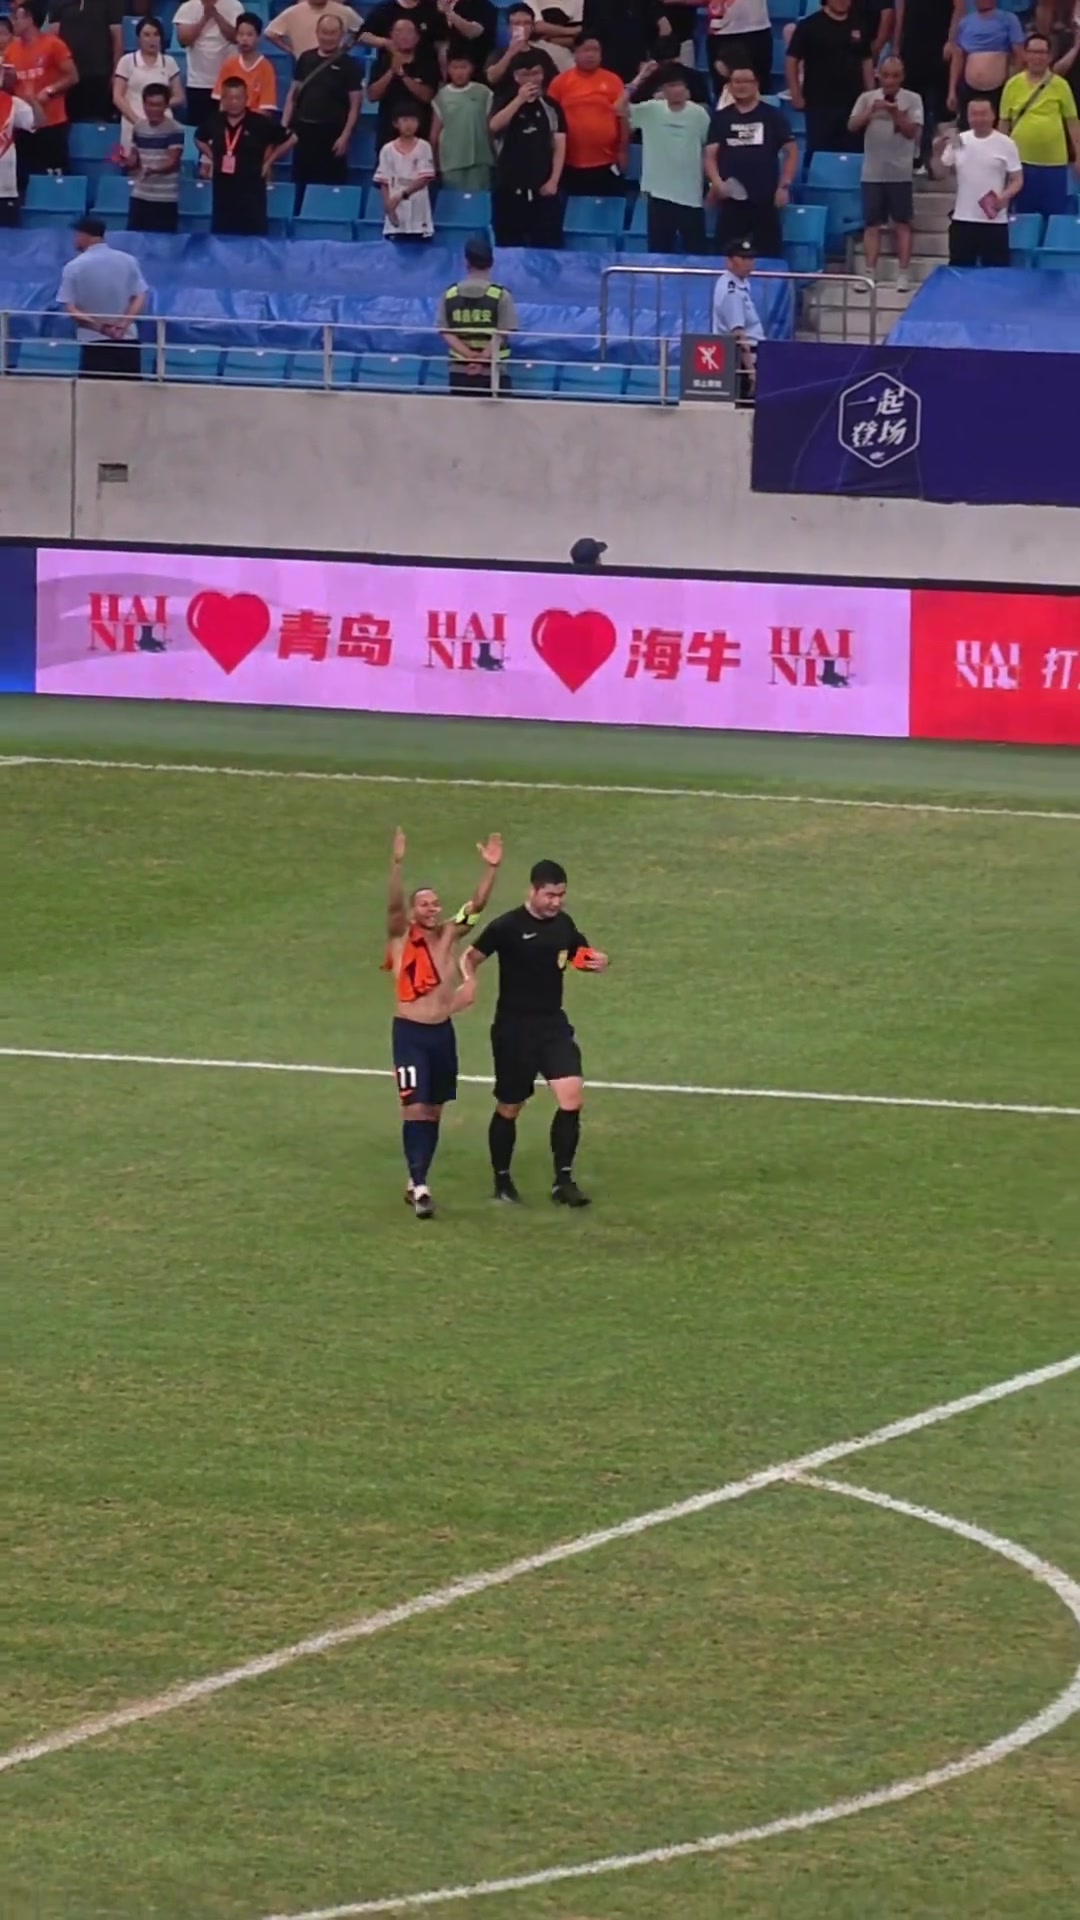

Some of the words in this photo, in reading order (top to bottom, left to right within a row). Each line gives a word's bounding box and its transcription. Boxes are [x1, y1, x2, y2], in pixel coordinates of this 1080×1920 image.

[846, 386, 905, 416] 一起
[851, 418, 907, 447] 登场
[89, 592, 169, 624] HAI
[277, 609, 393, 667] 青岛
[426, 610, 508, 641] HAI
[624, 626, 742, 683] 海牛
[768, 626, 855, 659] HAI
[955, 640, 1021, 666] HAI
[1041, 647, 1080, 690] 打
[398, 1065, 417, 1089] 11
